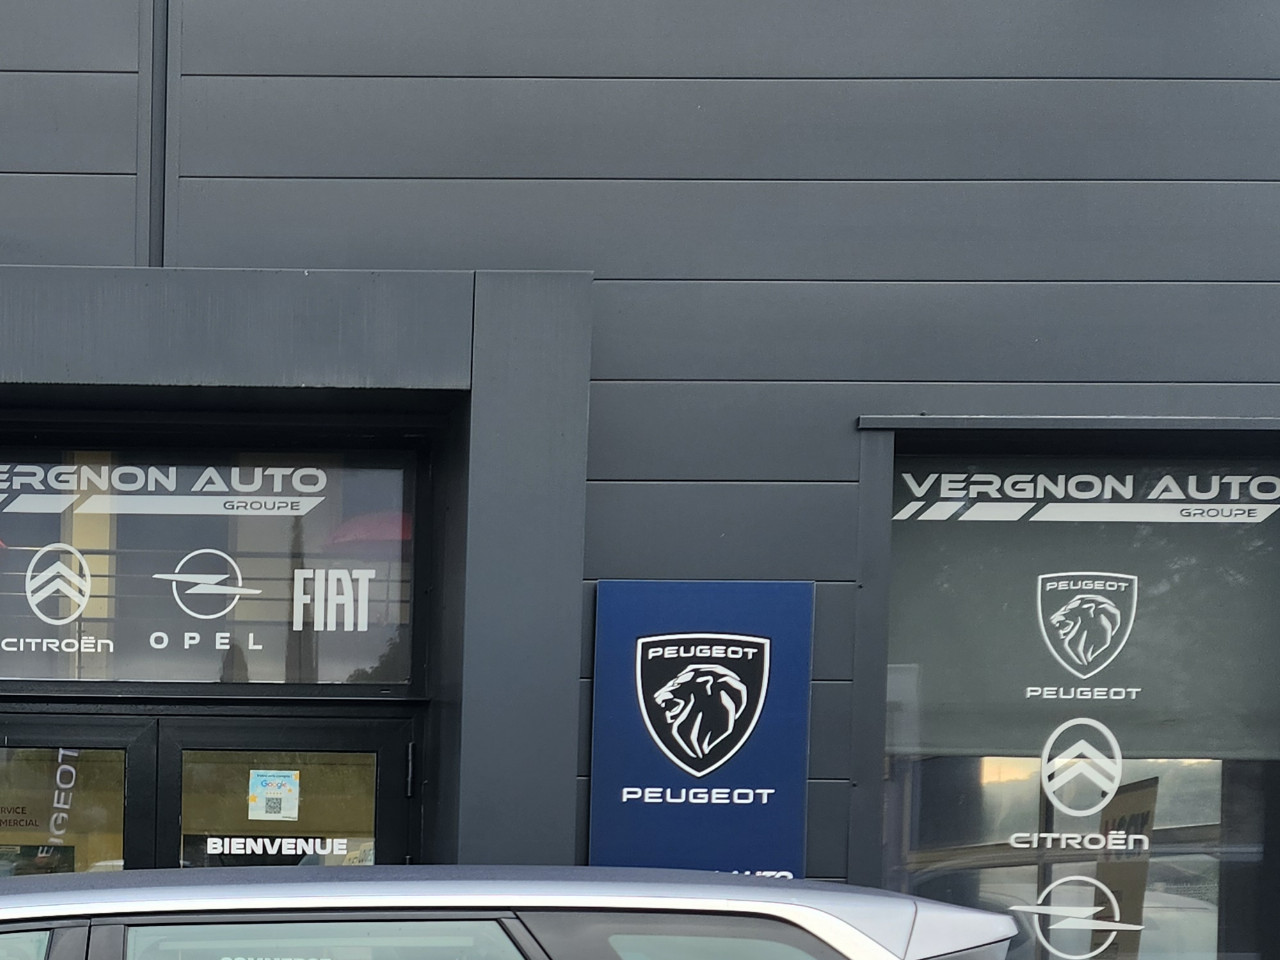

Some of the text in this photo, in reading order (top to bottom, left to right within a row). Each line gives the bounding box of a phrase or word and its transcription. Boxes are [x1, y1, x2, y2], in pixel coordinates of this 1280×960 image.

[191, 467, 327, 493] AUTO
[902, 473, 1280, 500] VERGNON AUTO
[224, 500, 300, 511] GROUPE
[1180, 508, 1258, 518] GROUPE
[1046, 580, 1129, 592] PEUGEOT
[293, 569, 376, 632] FIAT
[150, 632, 263, 650] OPEL
[648, 646, 758, 660] PEUGEOT
[1026, 687, 1141, 700] PEUGEOT
[622, 787, 775, 804] PEUGEOT
[207, 837, 348, 855] BIENVENUE
